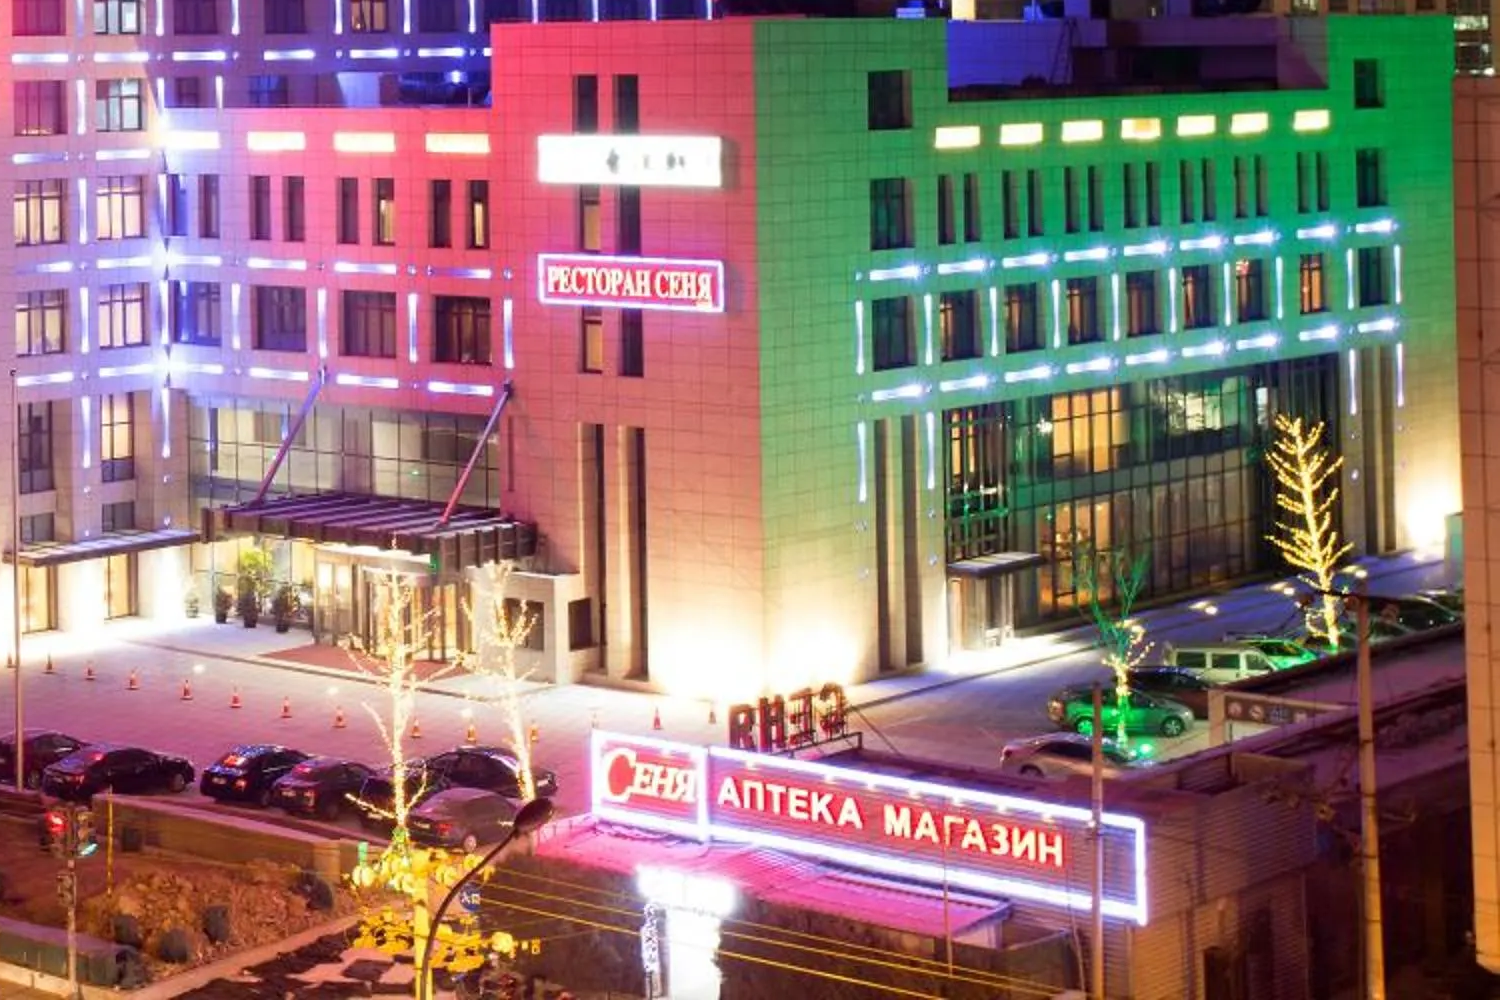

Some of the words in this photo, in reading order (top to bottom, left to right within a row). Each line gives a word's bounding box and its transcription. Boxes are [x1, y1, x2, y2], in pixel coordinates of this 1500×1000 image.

[548, 266, 651, 297] РЕСТОРАН
[654, 271, 713, 300] СЕНЯ
[717, 776, 864, 830] АПТЕКА
[883, 803, 1064, 868] МАГАЗИН
